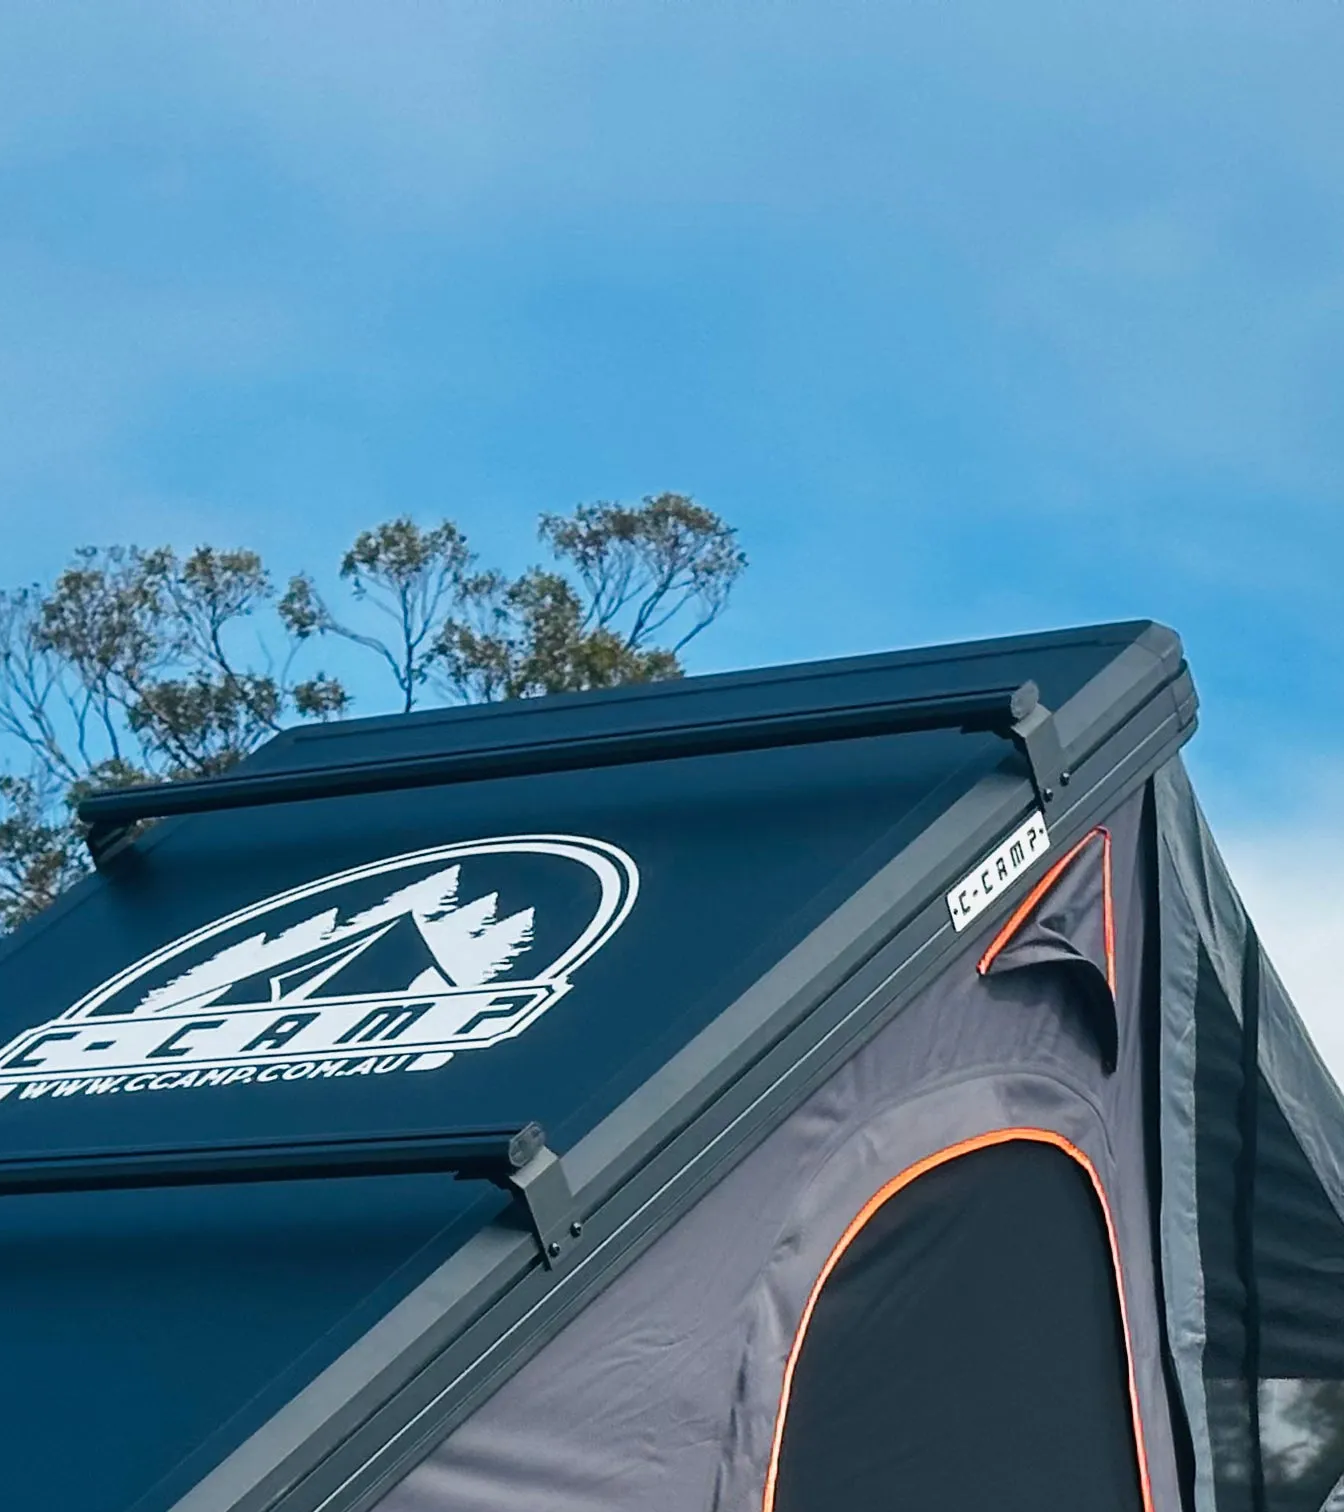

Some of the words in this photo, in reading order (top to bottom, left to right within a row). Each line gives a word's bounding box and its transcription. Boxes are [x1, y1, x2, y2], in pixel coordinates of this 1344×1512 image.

[958, 827, 1037, 915] C-CAMP
[2, 994, 527, 1070] C-CAMP
[18, 1055, 405, 1101] WWW.CCAMP.COM.AU
